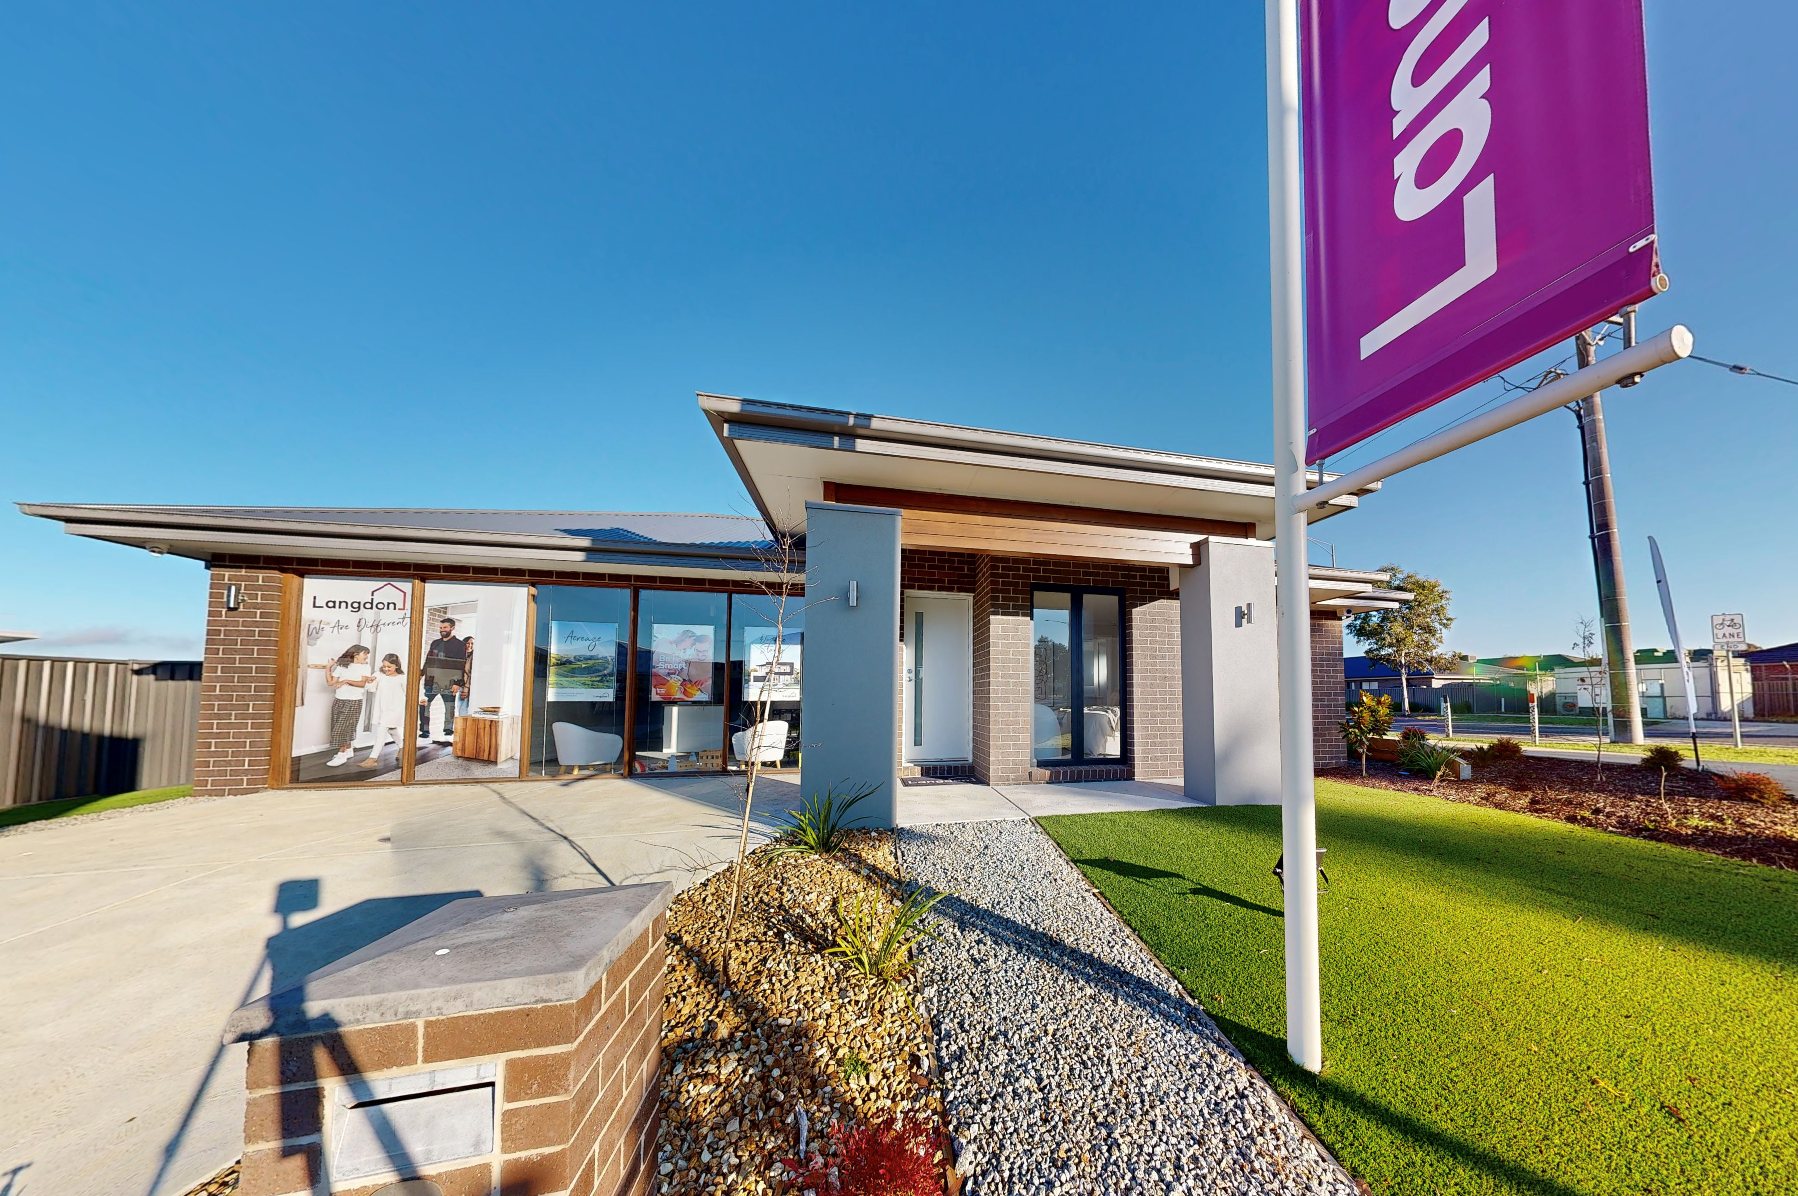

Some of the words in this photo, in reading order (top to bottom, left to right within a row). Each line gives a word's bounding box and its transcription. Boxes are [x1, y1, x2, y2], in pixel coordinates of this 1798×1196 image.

[1360, 0, 1497, 361] Lan
[312, 595, 397, 612] Langdon
[307, 619, 325, 637] We
[330, 619, 350, 635] Are
[356, 612, 411, 634] Different
[564, 629, 602, 652] Acreage
[658, 661, 687, 669] Smart
